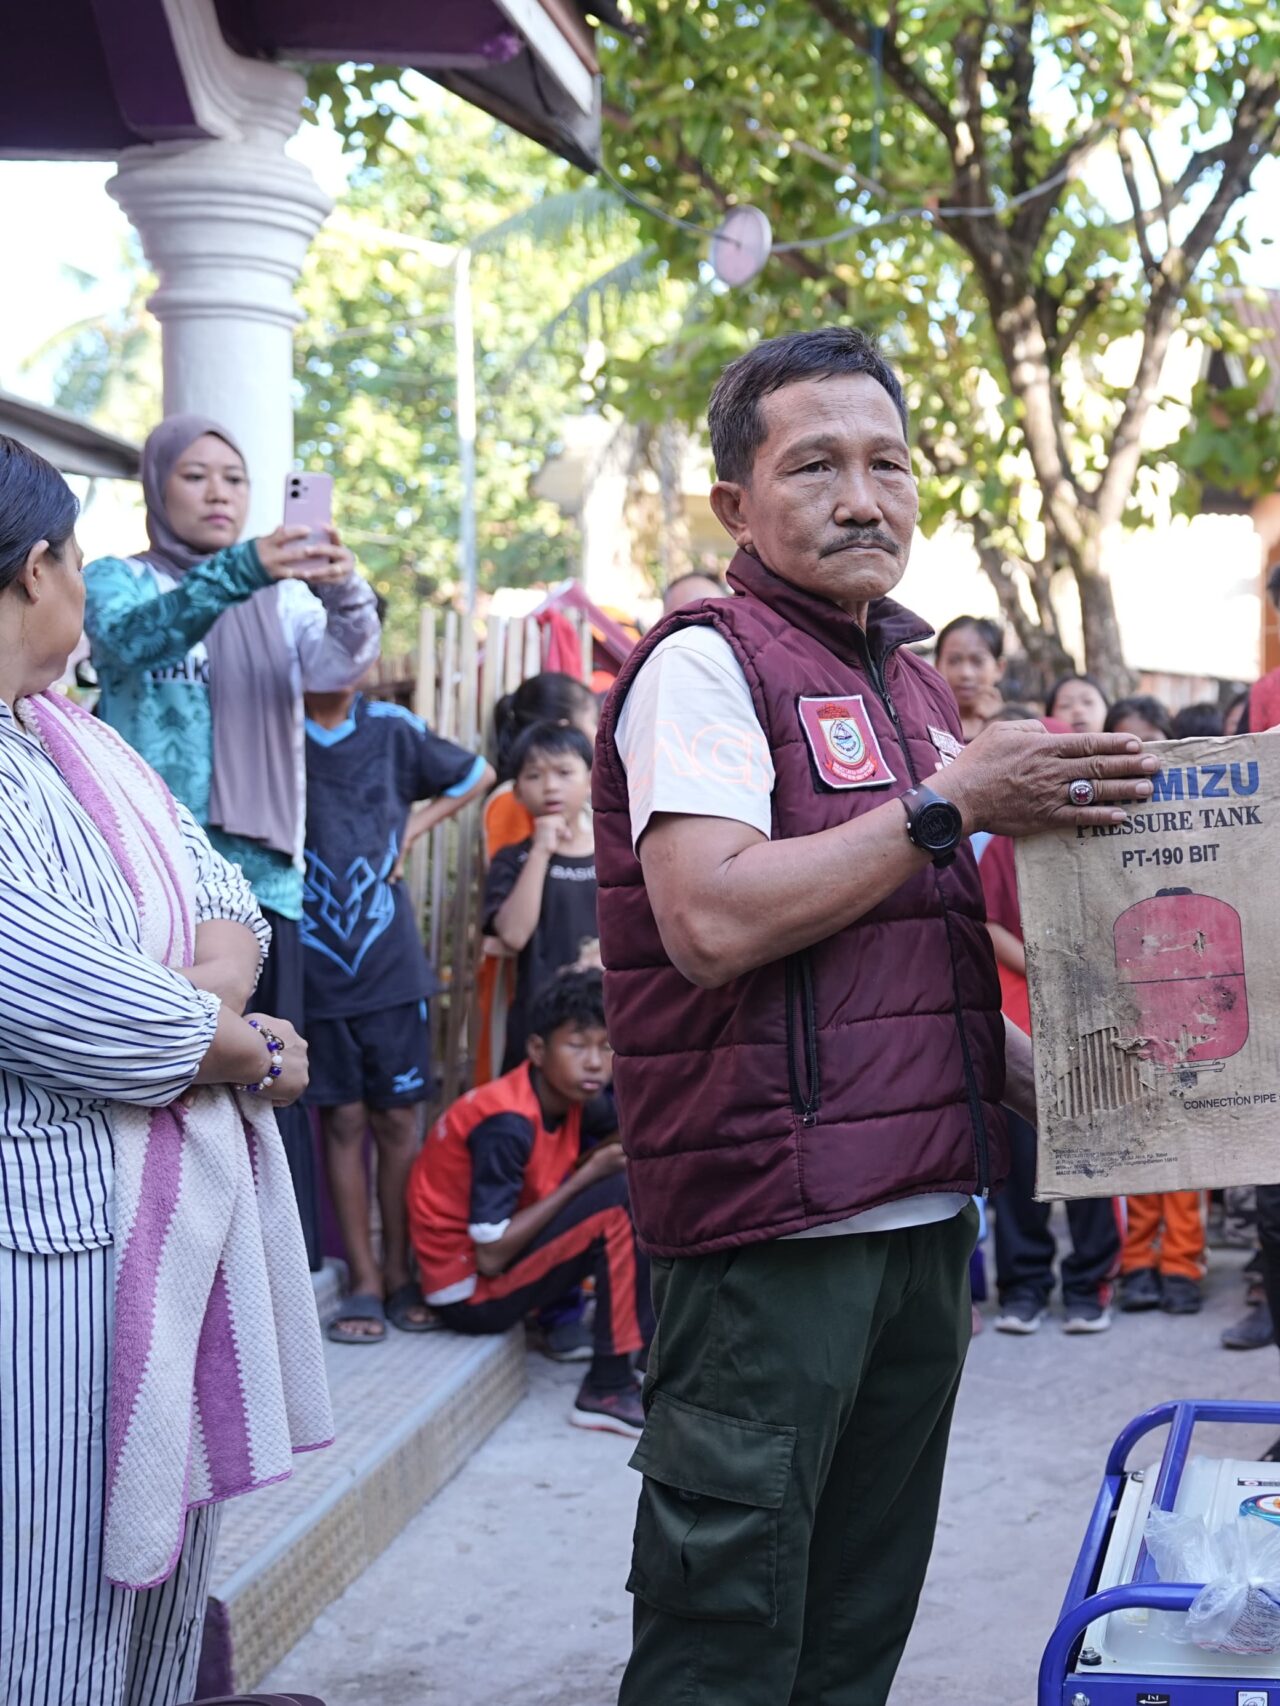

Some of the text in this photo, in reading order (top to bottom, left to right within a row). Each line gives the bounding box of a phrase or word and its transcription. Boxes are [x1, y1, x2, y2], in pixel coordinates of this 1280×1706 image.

[1103, 761, 1260, 806] MIZU
[1076, 805, 1264, 839] PRESSURE TANK
[1122, 843, 1220, 868] PT-190 BIT
[1183, 1095, 1251, 1110] CONNECTION
[1253, 1093, 1277, 1104] PIPE
